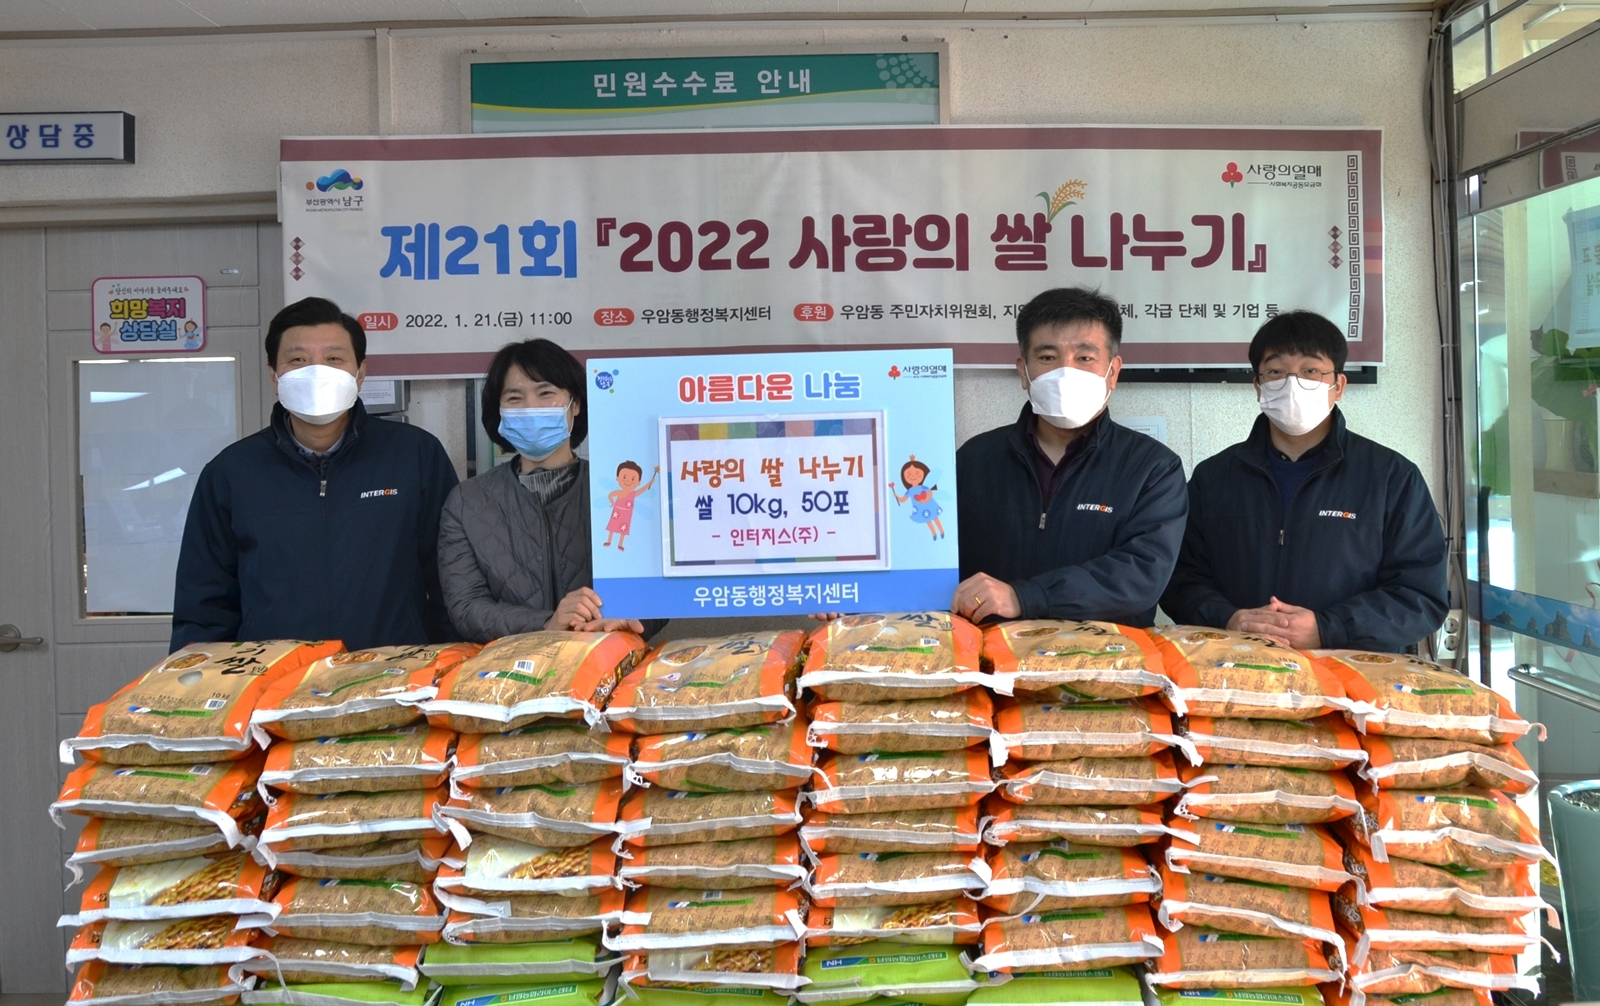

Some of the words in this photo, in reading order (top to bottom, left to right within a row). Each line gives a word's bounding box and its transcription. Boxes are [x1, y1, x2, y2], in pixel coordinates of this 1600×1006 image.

[593, 70, 738, 98] 민원수수료
[756, 68, 812, 95] 안내
[6, 123, 95, 150] 상담중
[1246, 164, 1322, 180] 사랑의열매
[342, 195, 364, 207] 남구
[380, 219, 577, 280] 제21회
[788, 213, 970, 273] 사랑의
[989, 212, 1052, 272] 쌀
[109, 297, 187, 320] 희망복지
[600, 310, 628, 324] 장소
[640, 305, 772, 324] 우암동행정복지센터
[800, 305, 827, 320] 후원
[840, 304, 885, 320] 우암동
[1144, 303, 1173, 319] 각급
[1178, 303, 1207, 319] 단체
[1212, 303, 1227, 319] 및
[1232, 303, 1260, 319] 기업
[119, 319, 178, 342] 상담실
[364, 314, 391, 329] 일시
[405, 314, 448, 328] 2022.
[529, 311, 573, 326] 11:00
[678, 373, 794, 403] 아름다운
[804, 372, 861, 400] 나눔
[680, 457, 745, 488] 사랑의
[760, 456, 784, 487] 쌀
[799, 454, 865, 483] 나누기
[360, 488, 398, 499] INTERGIS
[694, 494, 713, 520] 쌀
[726, 492, 788, 520] 10kg,
[800, 490, 850, 516] 50포
[1076, 503, 1114, 514] INTERGIS
[1318, 509, 1357, 520] INTERGIS
[729, 526, 819, 547] 인터지스(주)
[693, 581, 860, 608] 우암동행정복지센터
[826, 959, 843, 967] NH
